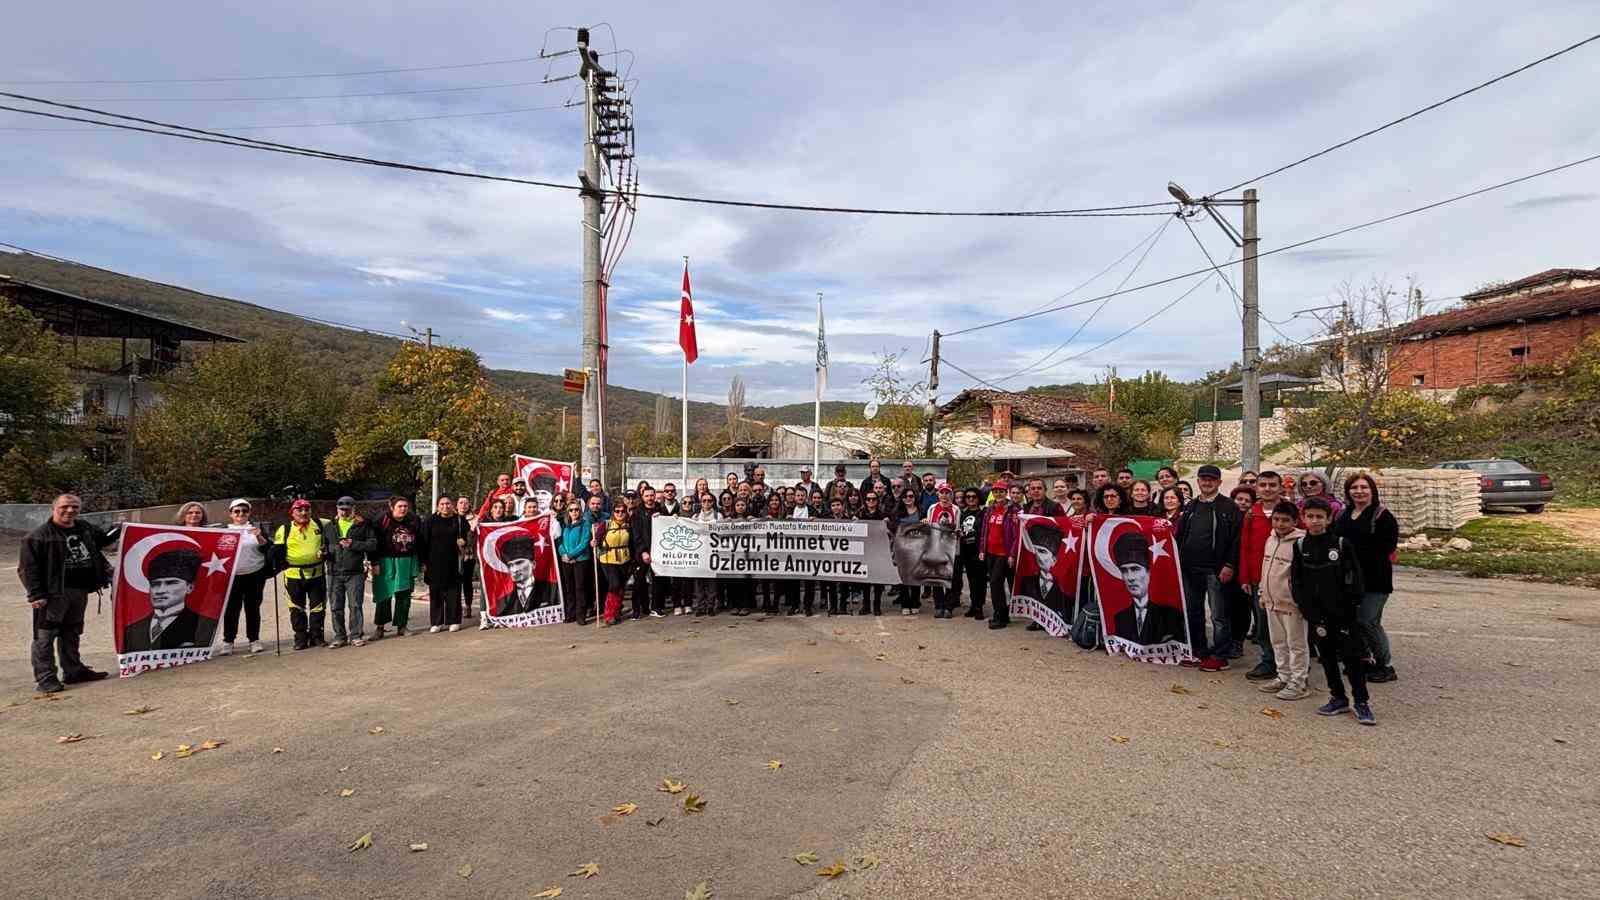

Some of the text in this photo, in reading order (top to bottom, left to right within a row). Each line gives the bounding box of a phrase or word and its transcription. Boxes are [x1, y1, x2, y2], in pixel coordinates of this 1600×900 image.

[731, 522, 751, 530] Önder
[753, 522, 768, 530] Gazi
[769, 522, 796, 531] Mustafa
[799, 522, 820, 531] Kemal
[709, 531, 849, 552] Saygı, Minnet ve
[662, 551, 700, 559] NİLÜFER
[709, 550, 867, 577] Özlemle Anıyoruz.
